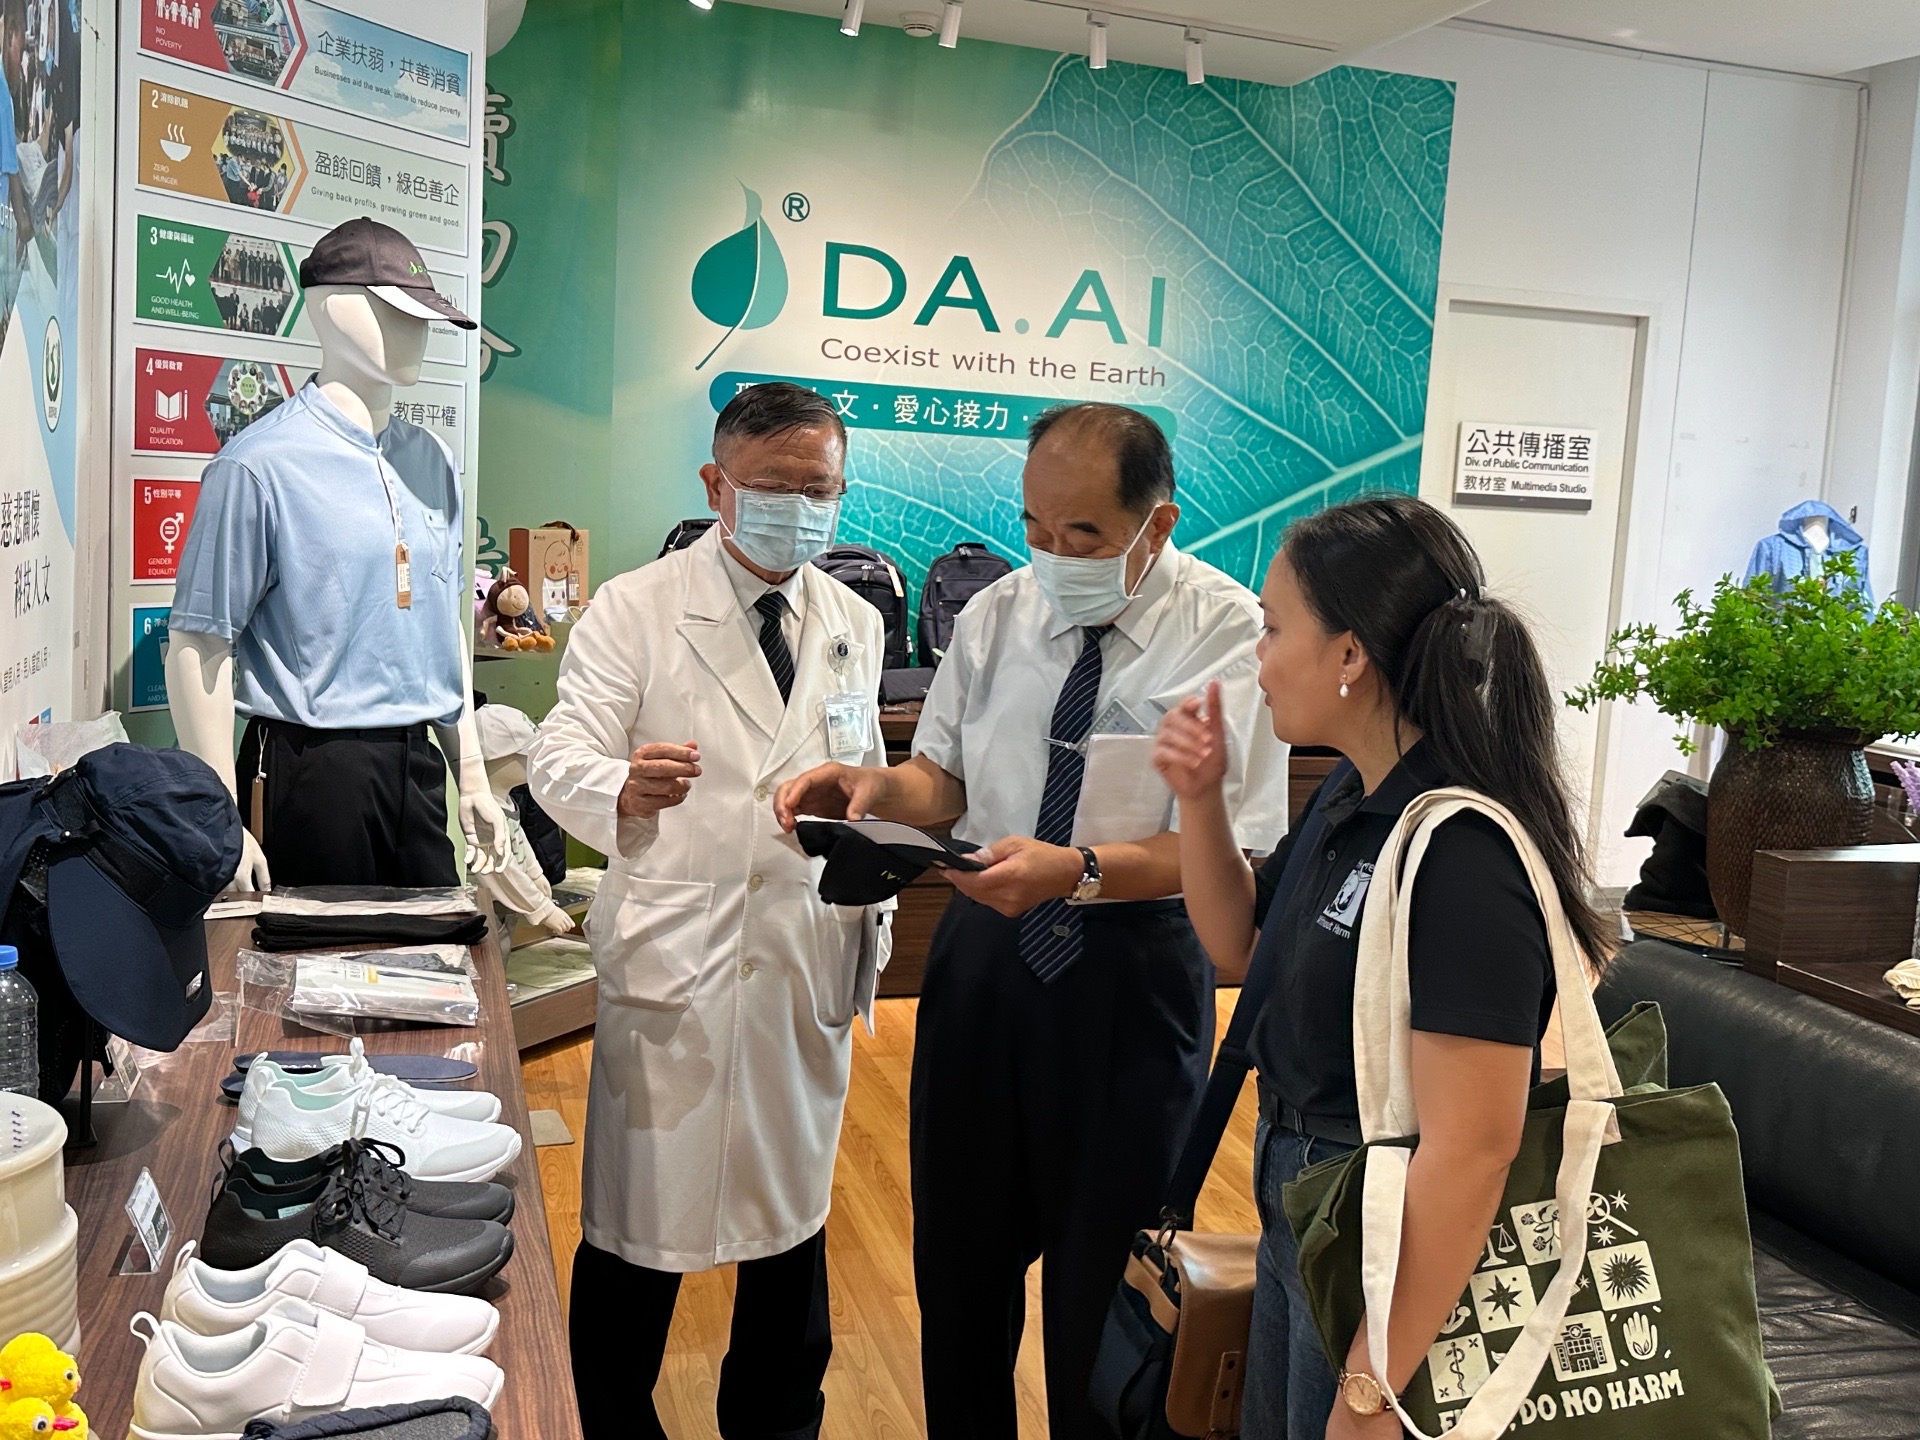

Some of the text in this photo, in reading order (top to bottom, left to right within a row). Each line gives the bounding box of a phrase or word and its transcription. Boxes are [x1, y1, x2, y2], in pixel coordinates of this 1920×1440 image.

[155, 26, 166, 36] NO
[155, 38, 183, 51] POVERTY
[317, 30, 461, 97] 企業扶弱，共善消貧
[314, 65, 351, 84] Businesses
[352, 78, 362, 88] aid
[363, 81, 374, 91] the
[393, 91, 409, 102] unite
[410, 95, 417, 103] to
[417, 98, 438, 110] reduce
[151, 89, 159, 109] 2
[153, 163, 170, 173] ZERO
[152, 174, 179, 186] HUNGER
[314, 150, 460, 207] 盈餘回饋，綠色善企
[311, 186, 334, 200] Giving
[336, 192, 353, 204] back
[380, 204, 407, 217] growing
[408, 210, 428, 220] green
[429, 214, 442, 224] and
[150, 226, 158, 245] 3
[151, 295, 193, 308] GOOD HEALTH
[151, 306, 200, 320] AND WELL-BEING
[145, 357, 154, 376] 4
[821, 338, 1166, 387] Coexist with the Earth
[149, 426, 175, 435] QUALITY
[149, 436, 184, 446] EDUCATION
[1467, 429, 1591, 461] 公共傳播室
[1465, 456, 1589, 473] Div. of Public Communication
[1463, 475, 1587, 494] 教材室 Multimedia Studio
[144, 486, 152, 505] 5
[148, 557, 172, 565] GENDER
[148, 567, 177, 576] EQUALITY
[13, 555, 51, 619] 科技人文
[143, 617, 152, 635] 6
[147, 684, 167, 693] CLEAN
[147, 693, 161, 702] AND
[1520, 1393, 1557, 1426] DO
[1559, 1386, 1603, 1418] NO
[1606, 1368, 1685, 1411] HARM
